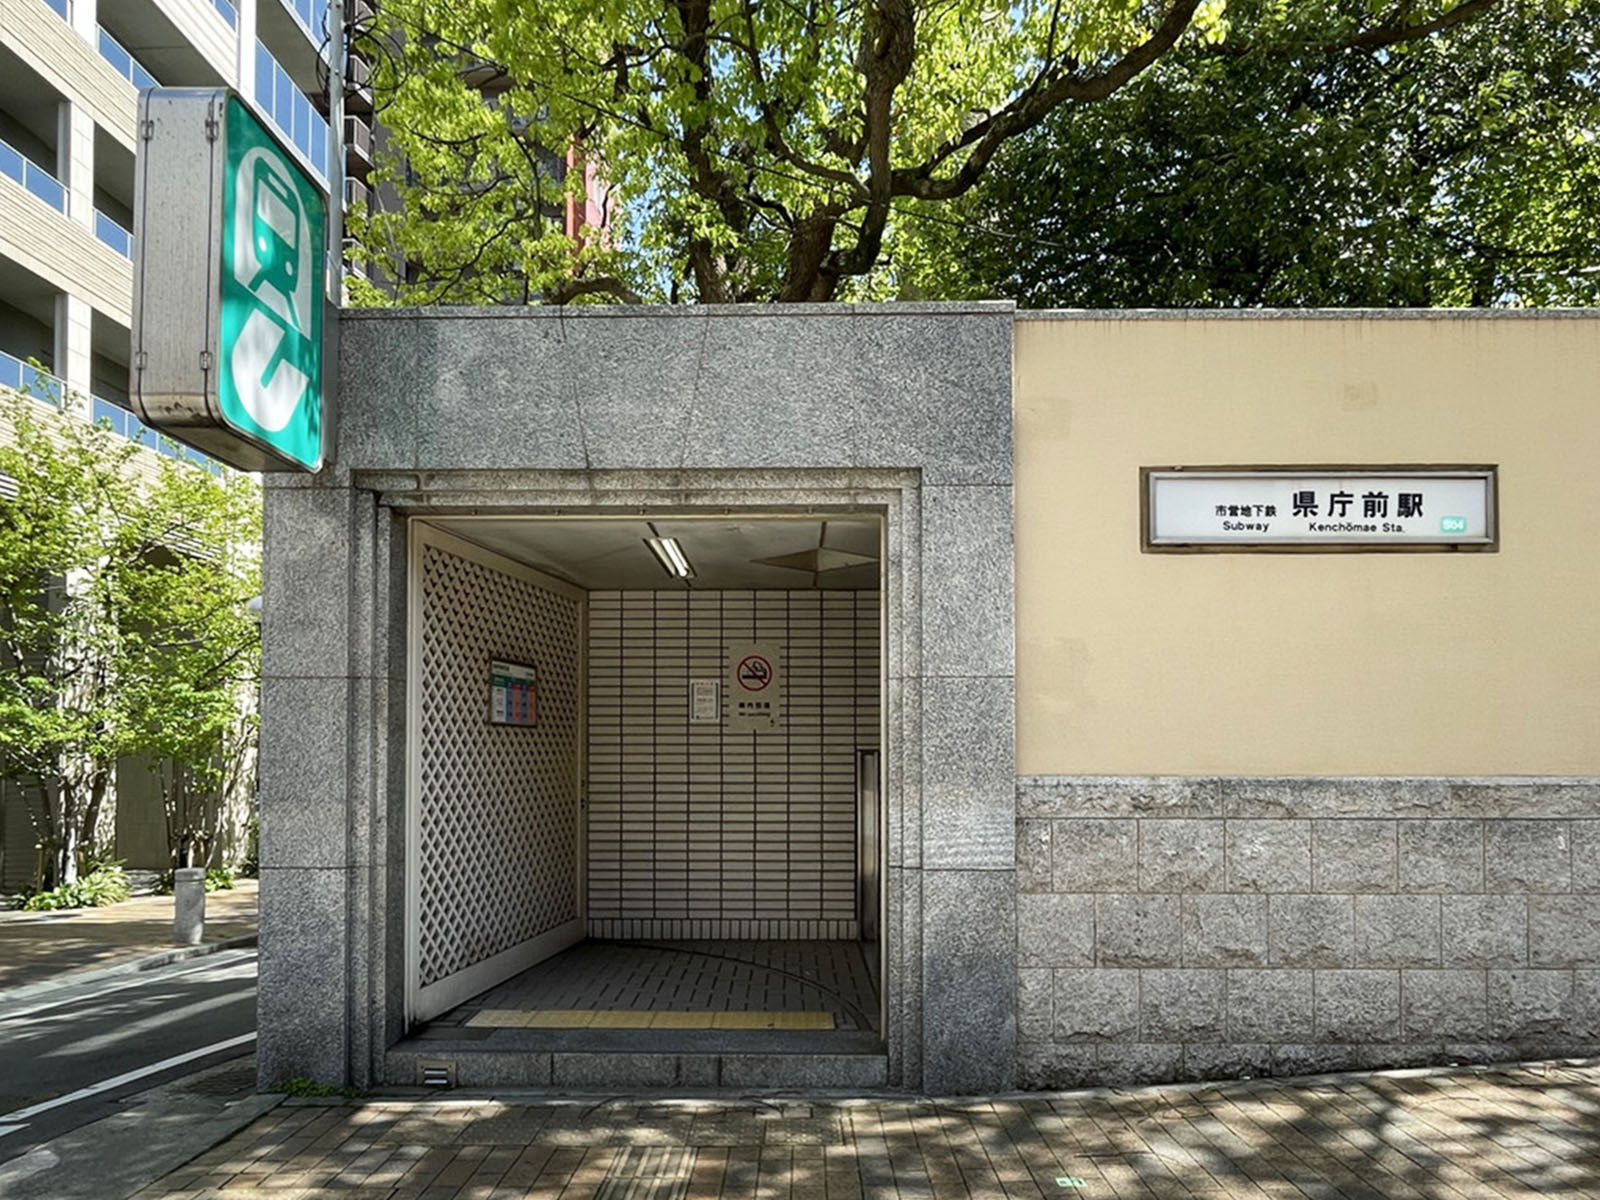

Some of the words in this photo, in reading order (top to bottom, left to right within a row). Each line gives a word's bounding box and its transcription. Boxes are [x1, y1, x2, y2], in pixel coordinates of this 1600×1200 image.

[1215, 504, 1277, 517] 市営地下鉄
[1292, 490, 1424, 518] 県庁前駅
[1223, 520, 1270, 533] Subway
[1382, 522, 1406, 533] Sta.
